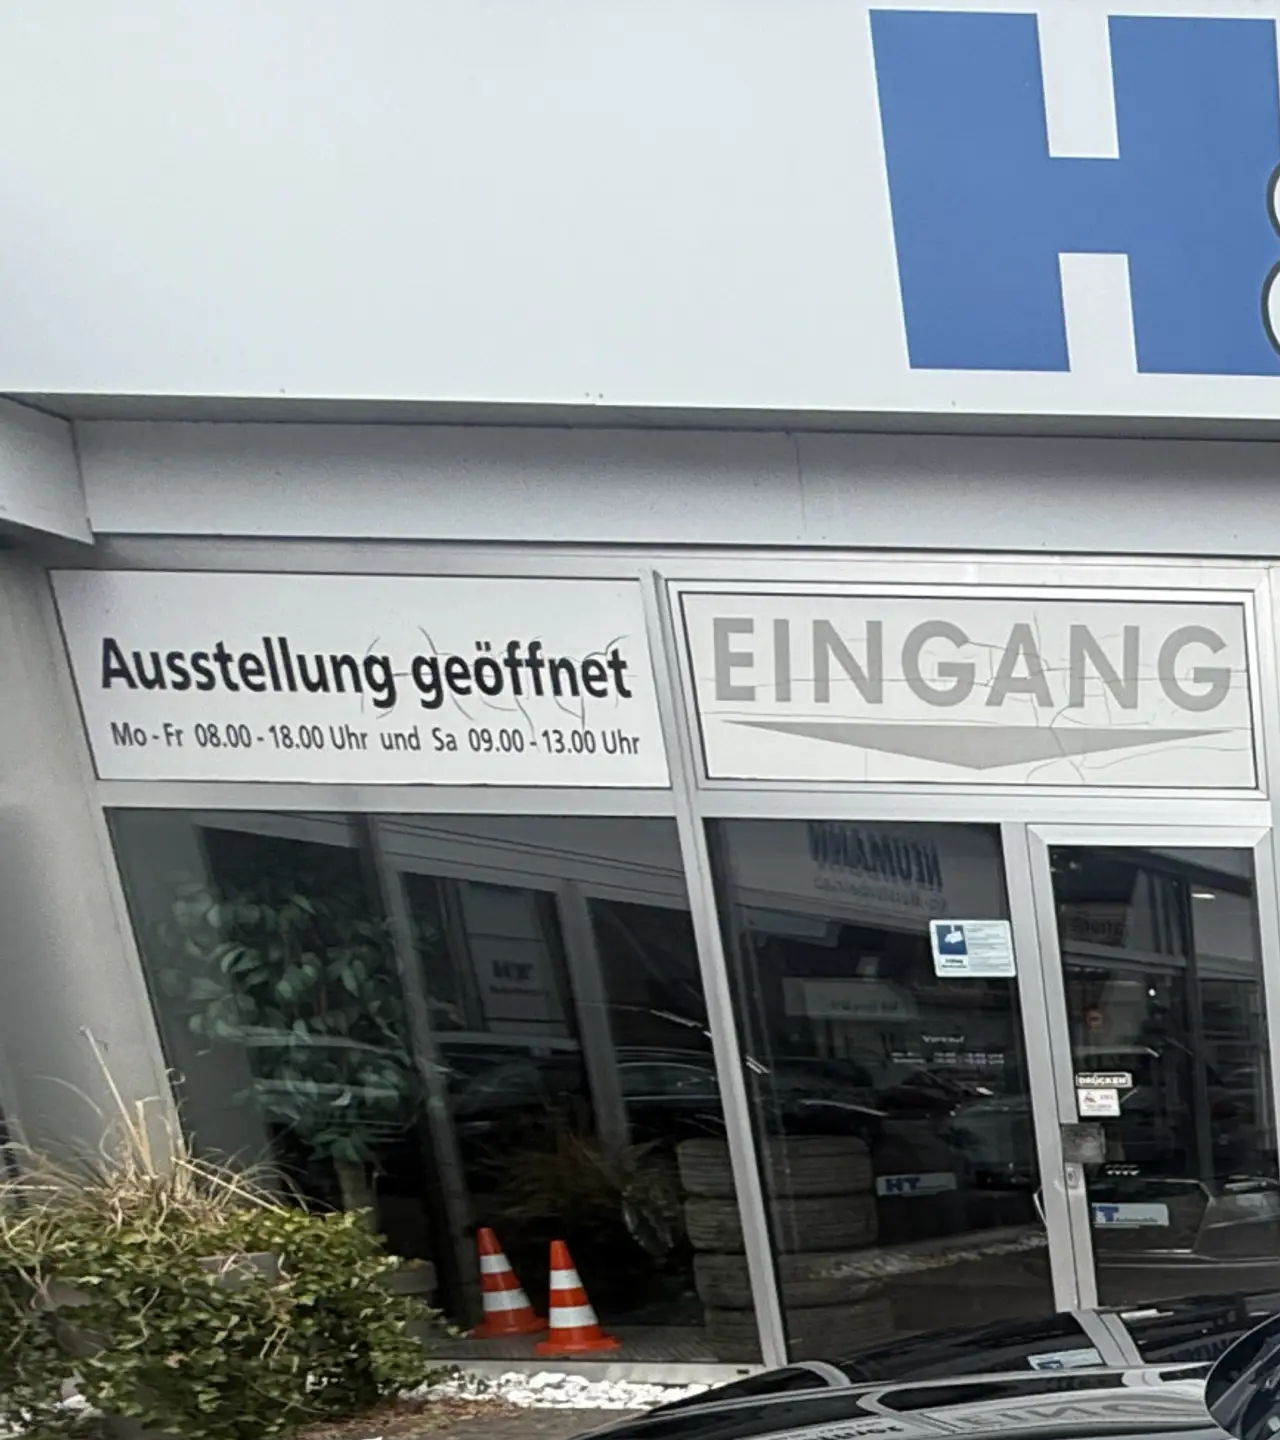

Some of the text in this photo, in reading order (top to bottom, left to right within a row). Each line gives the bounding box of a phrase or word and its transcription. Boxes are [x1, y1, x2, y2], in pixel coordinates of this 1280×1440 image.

[102, 637, 632, 710] Ausstellung geöffnet
[713, 617, 1232, 711] EINGANG
[329, 725, 368, 750] Uhr
[380, 726, 421, 750] und
[431, 727, 458, 752] Sa
[601, 730, 640, 755] Uhr
